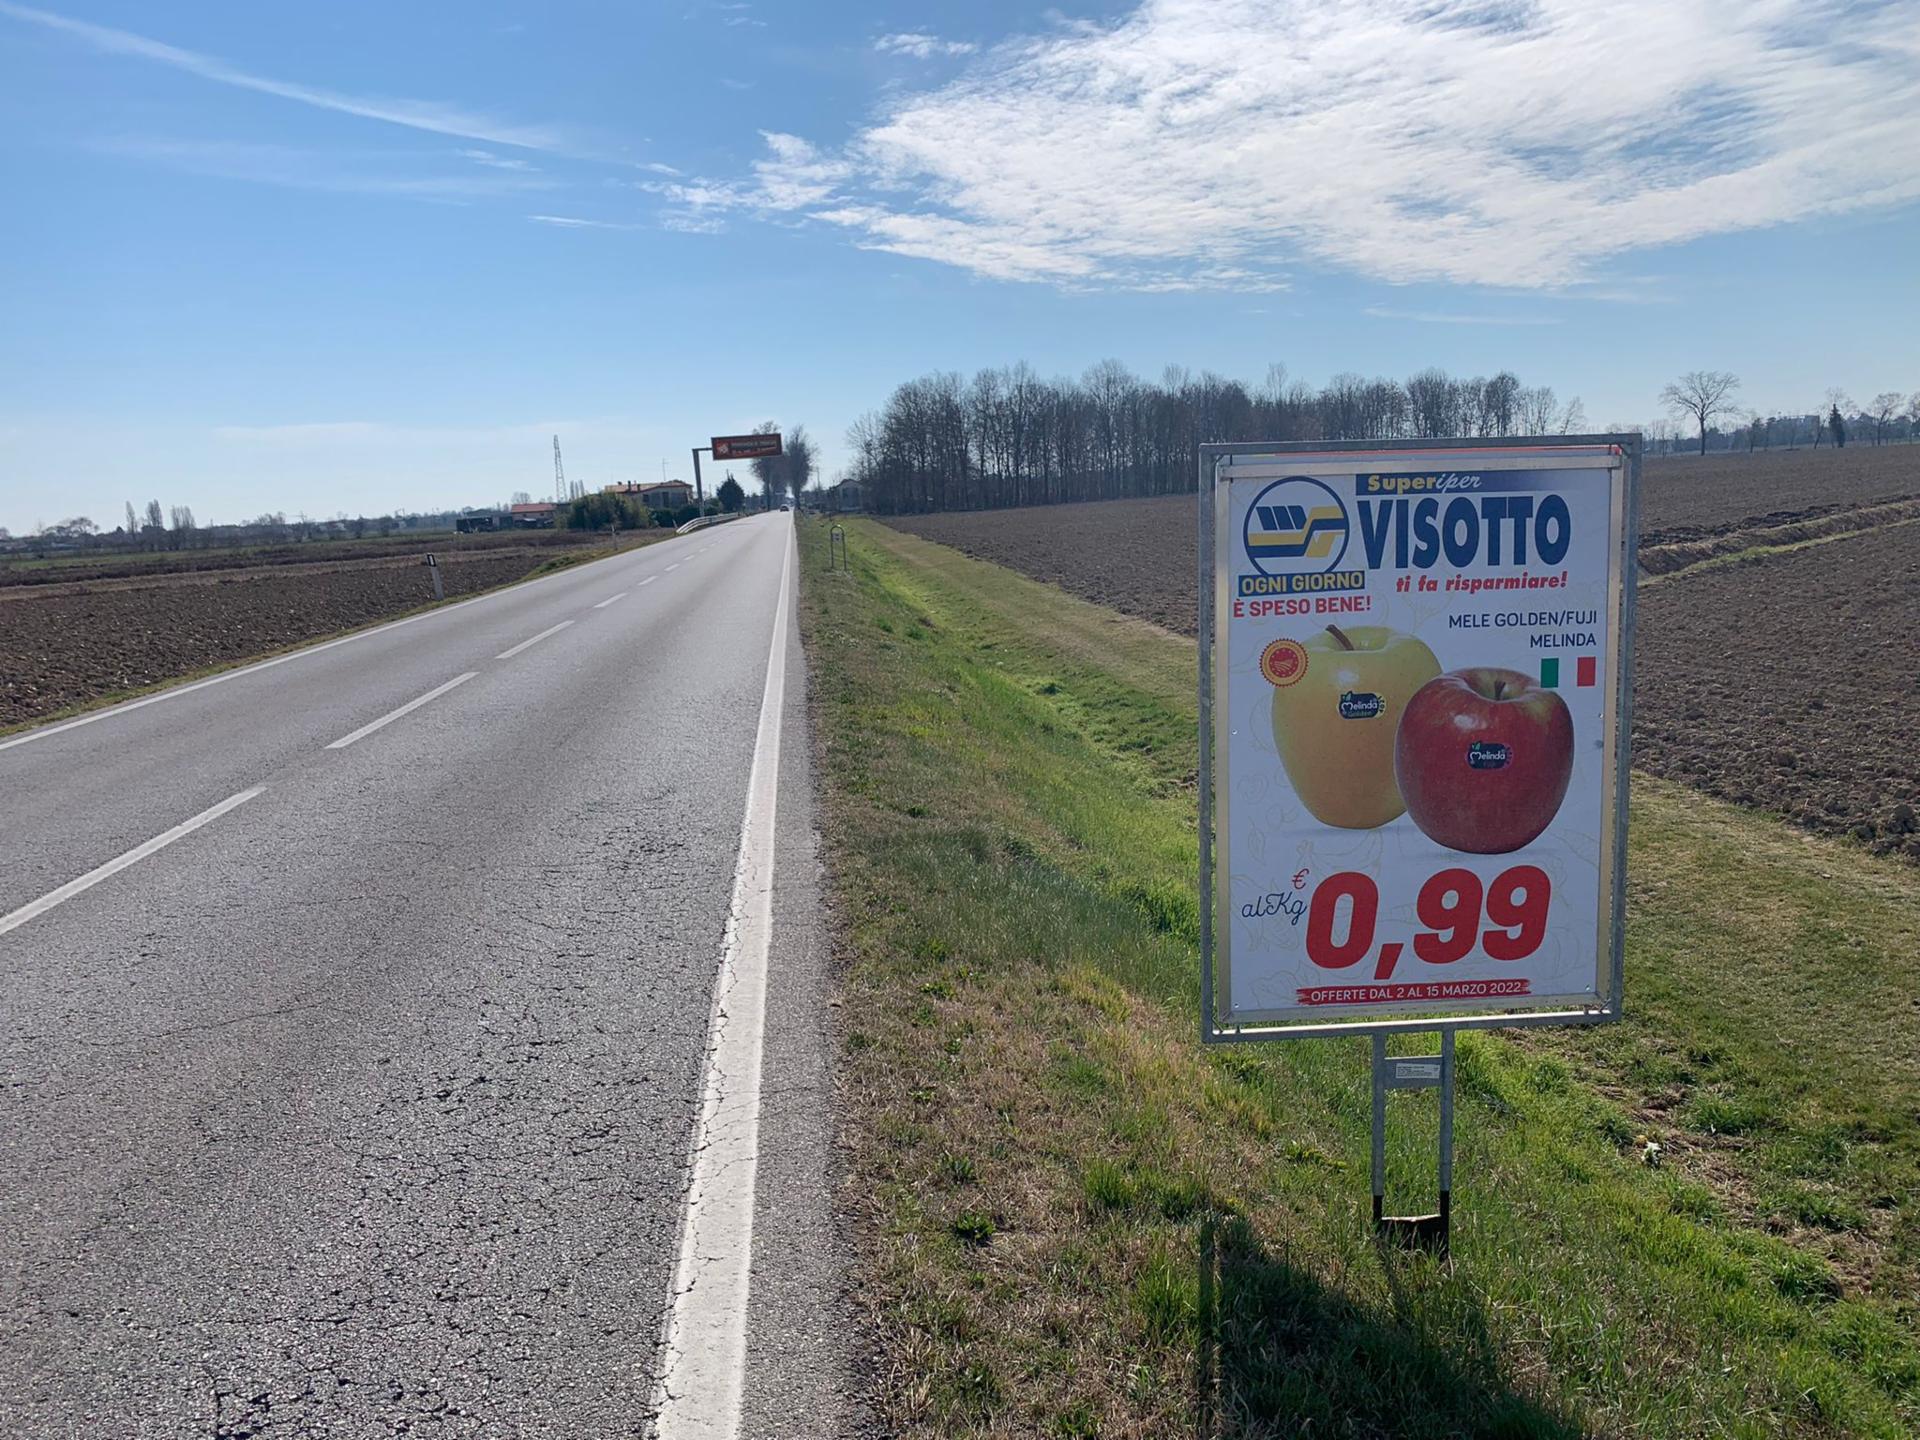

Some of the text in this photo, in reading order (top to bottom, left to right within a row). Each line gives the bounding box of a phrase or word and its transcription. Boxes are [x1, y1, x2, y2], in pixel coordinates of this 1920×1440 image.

[1356, 494, 1572, 570] VISOTTO
[1241, 571, 1363, 595] OGNI GIORNO
[1396, 570, 1568, 594] ti fa risparmiare!
[1249, 599, 1311, 617] SPESO
[1315, 595, 1371, 614] BENE!
[1449, 610, 1597, 629] MELE GOLDEN/FUJI
[1530, 632, 1597, 649] MELINDA
[1341, 699, 1378, 713] Melinda
[1470, 750, 1506, 764] Melinda
[1292, 868, 1310, 890] €
[1306, 865, 1551, 980] 0,99
[1311, 981, 1522, 1002] OFFERTE DAL 2 AL 15 MARZO 2022
